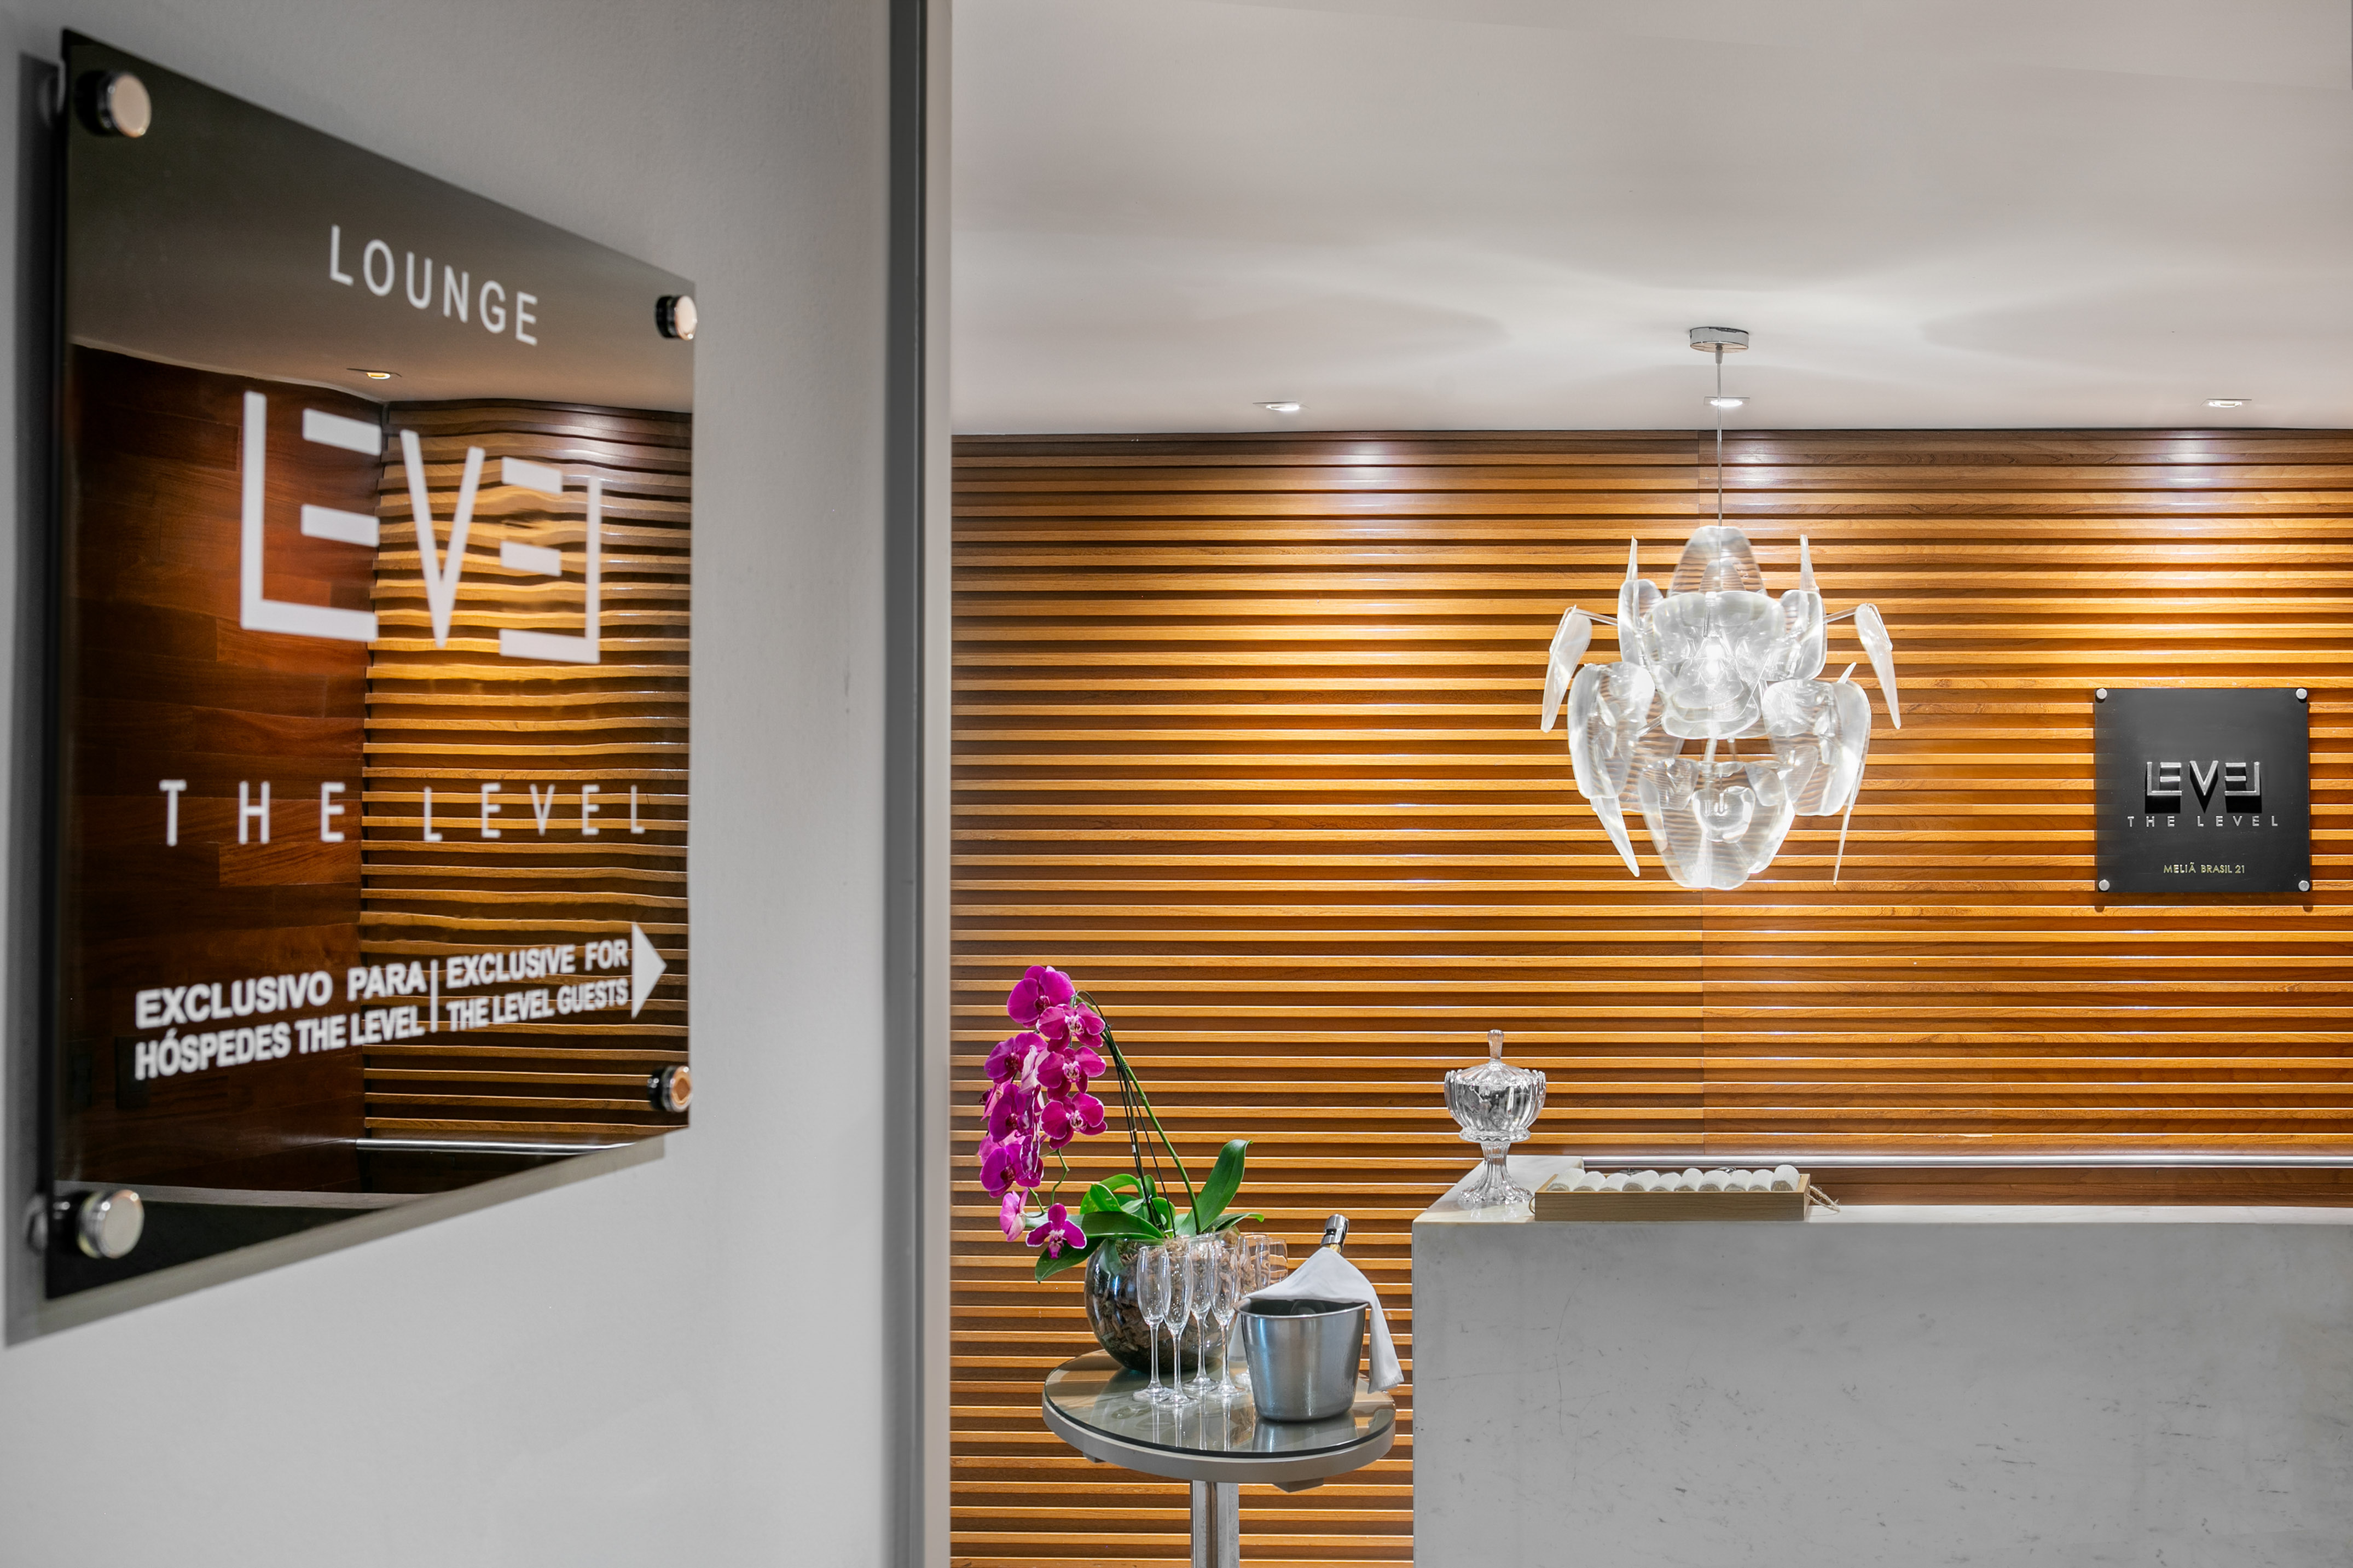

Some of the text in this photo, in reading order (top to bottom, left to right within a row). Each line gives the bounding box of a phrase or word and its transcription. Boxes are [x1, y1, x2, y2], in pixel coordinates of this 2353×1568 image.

[329, 224, 538, 346] LOUNGE
[159, 780, 645, 846] THE LEVEL
[2127, 816, 2279, 827] THE LEVEL
[2200, 864, 2233, 874] BRASIL
[2234, 864, 2245, 874] 21
[446, 939, 629, 989] EXCLUSIVE FOR
[135, 960, 427, 1029] EXCLUSIVO PARA
[447, 978, 629, 1031] THE LEVEL GUESTS
[134, 1005, 425, 1080] HÓSPEDES THE LEVEL
